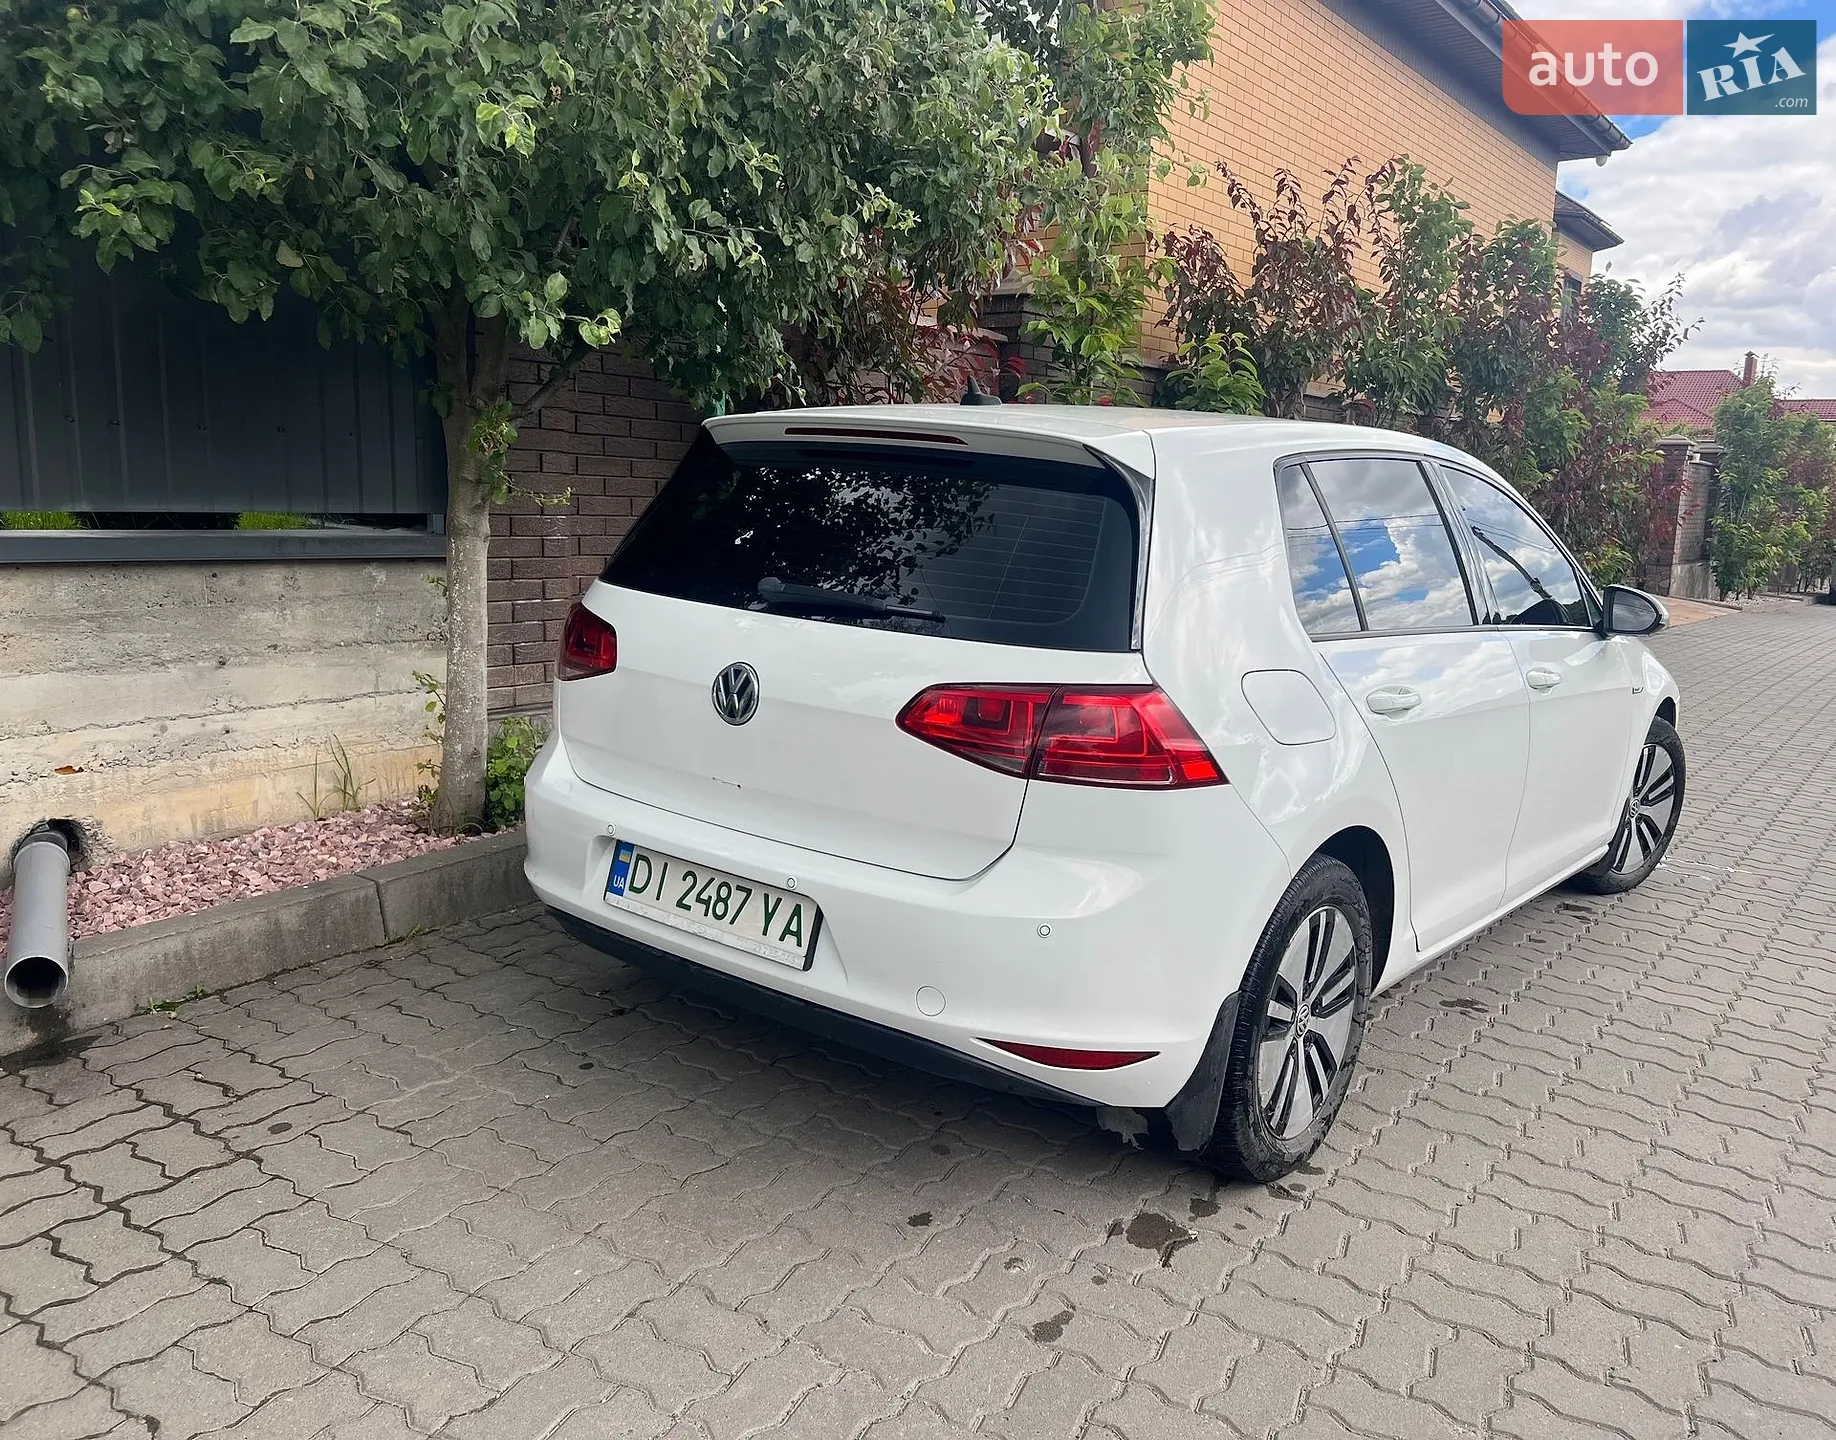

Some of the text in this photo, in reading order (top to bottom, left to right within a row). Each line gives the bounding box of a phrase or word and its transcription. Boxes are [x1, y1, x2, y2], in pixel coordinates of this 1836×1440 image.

[612, 875, 626, 889] UA
[628, 853, 669, 901] DI
[675, 870, 752, 926] 2487
[761, 892, 803, 948] YA
